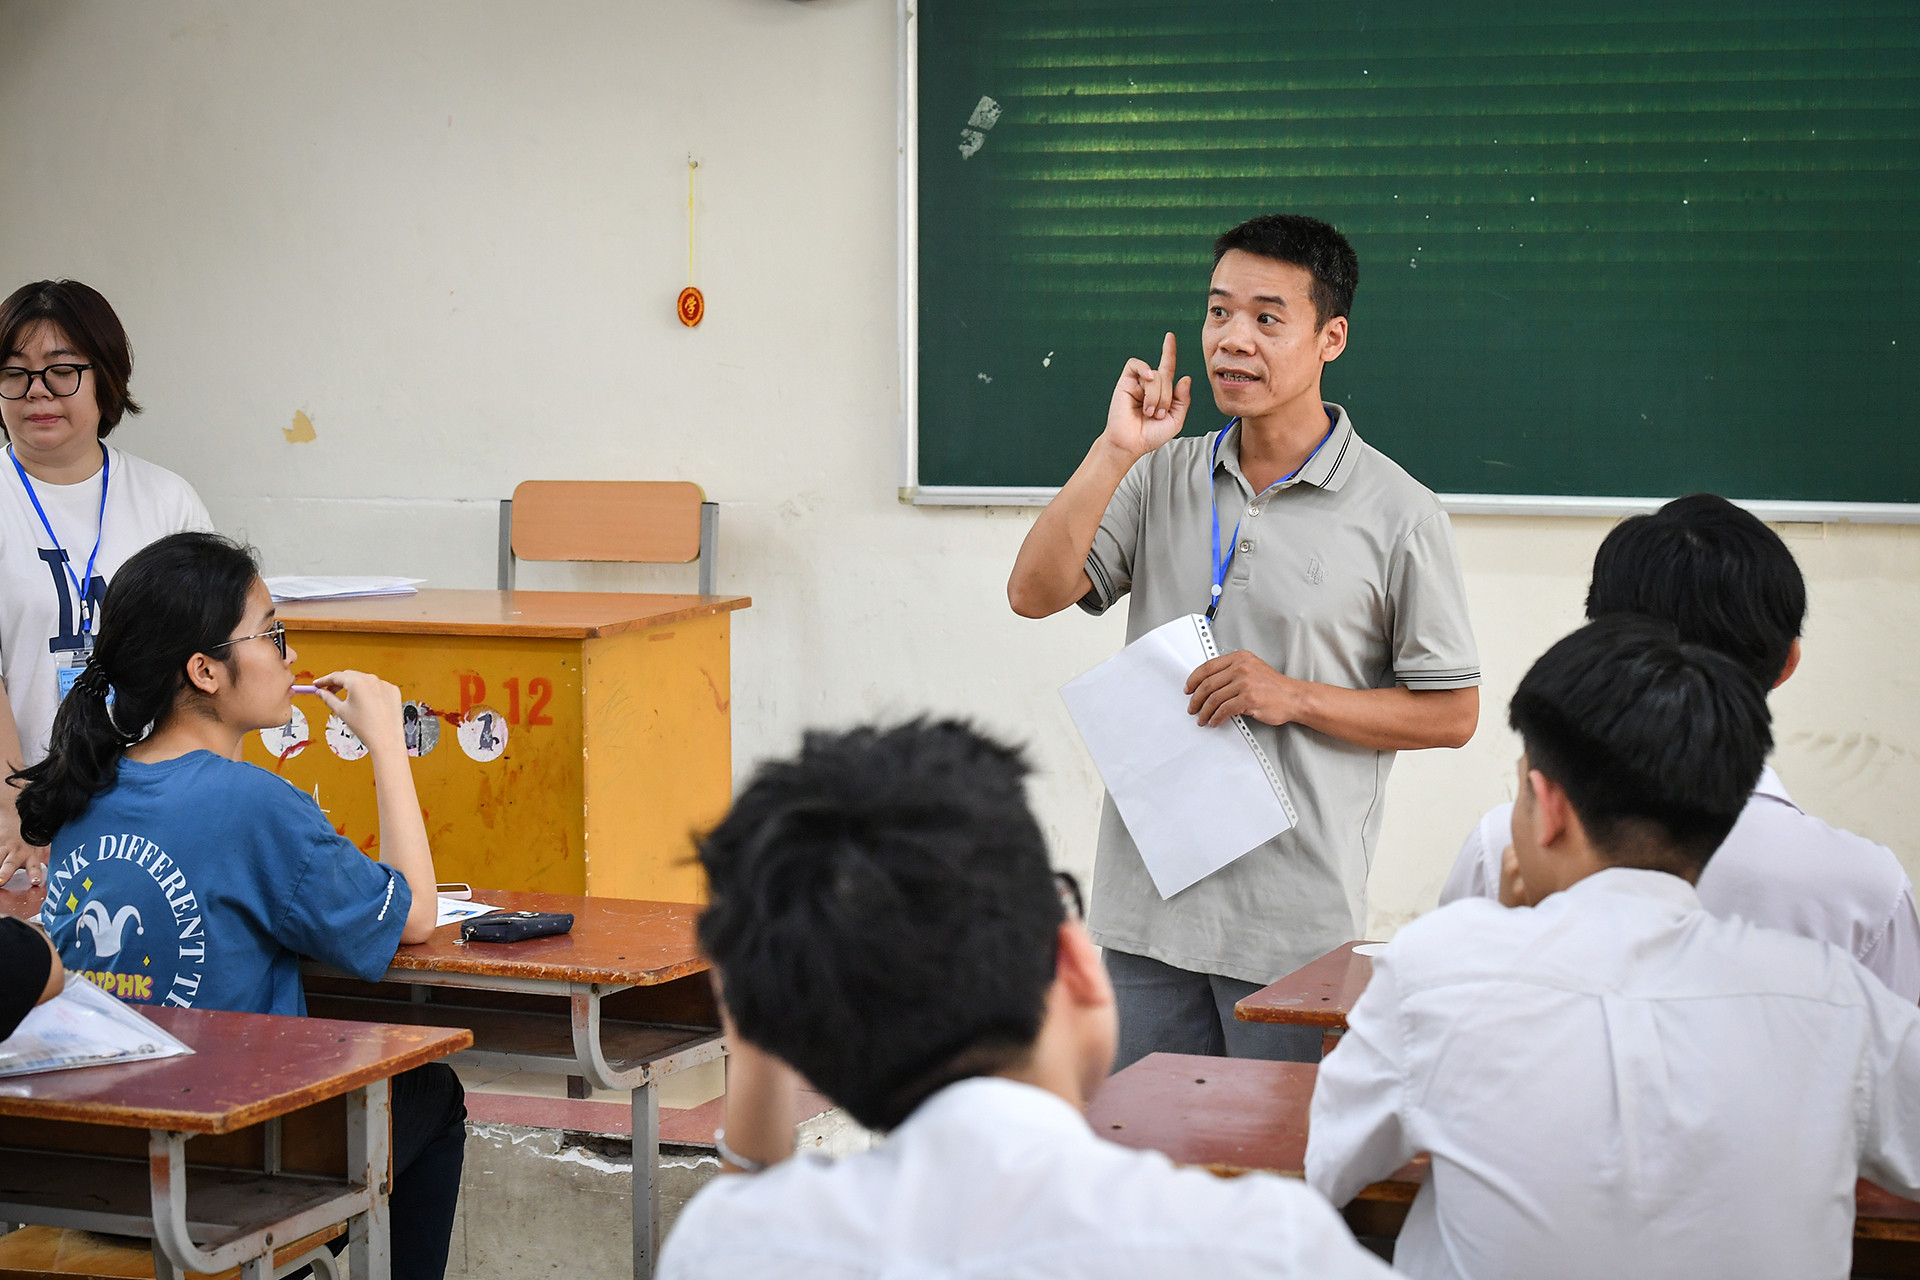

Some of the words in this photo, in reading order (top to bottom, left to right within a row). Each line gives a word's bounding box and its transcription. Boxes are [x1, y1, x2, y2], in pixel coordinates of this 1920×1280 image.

[503, 677, 553, 726] 12
[43, 843, 90, 938] HINK
[97, 833, 205, 964] DIFFERENT
